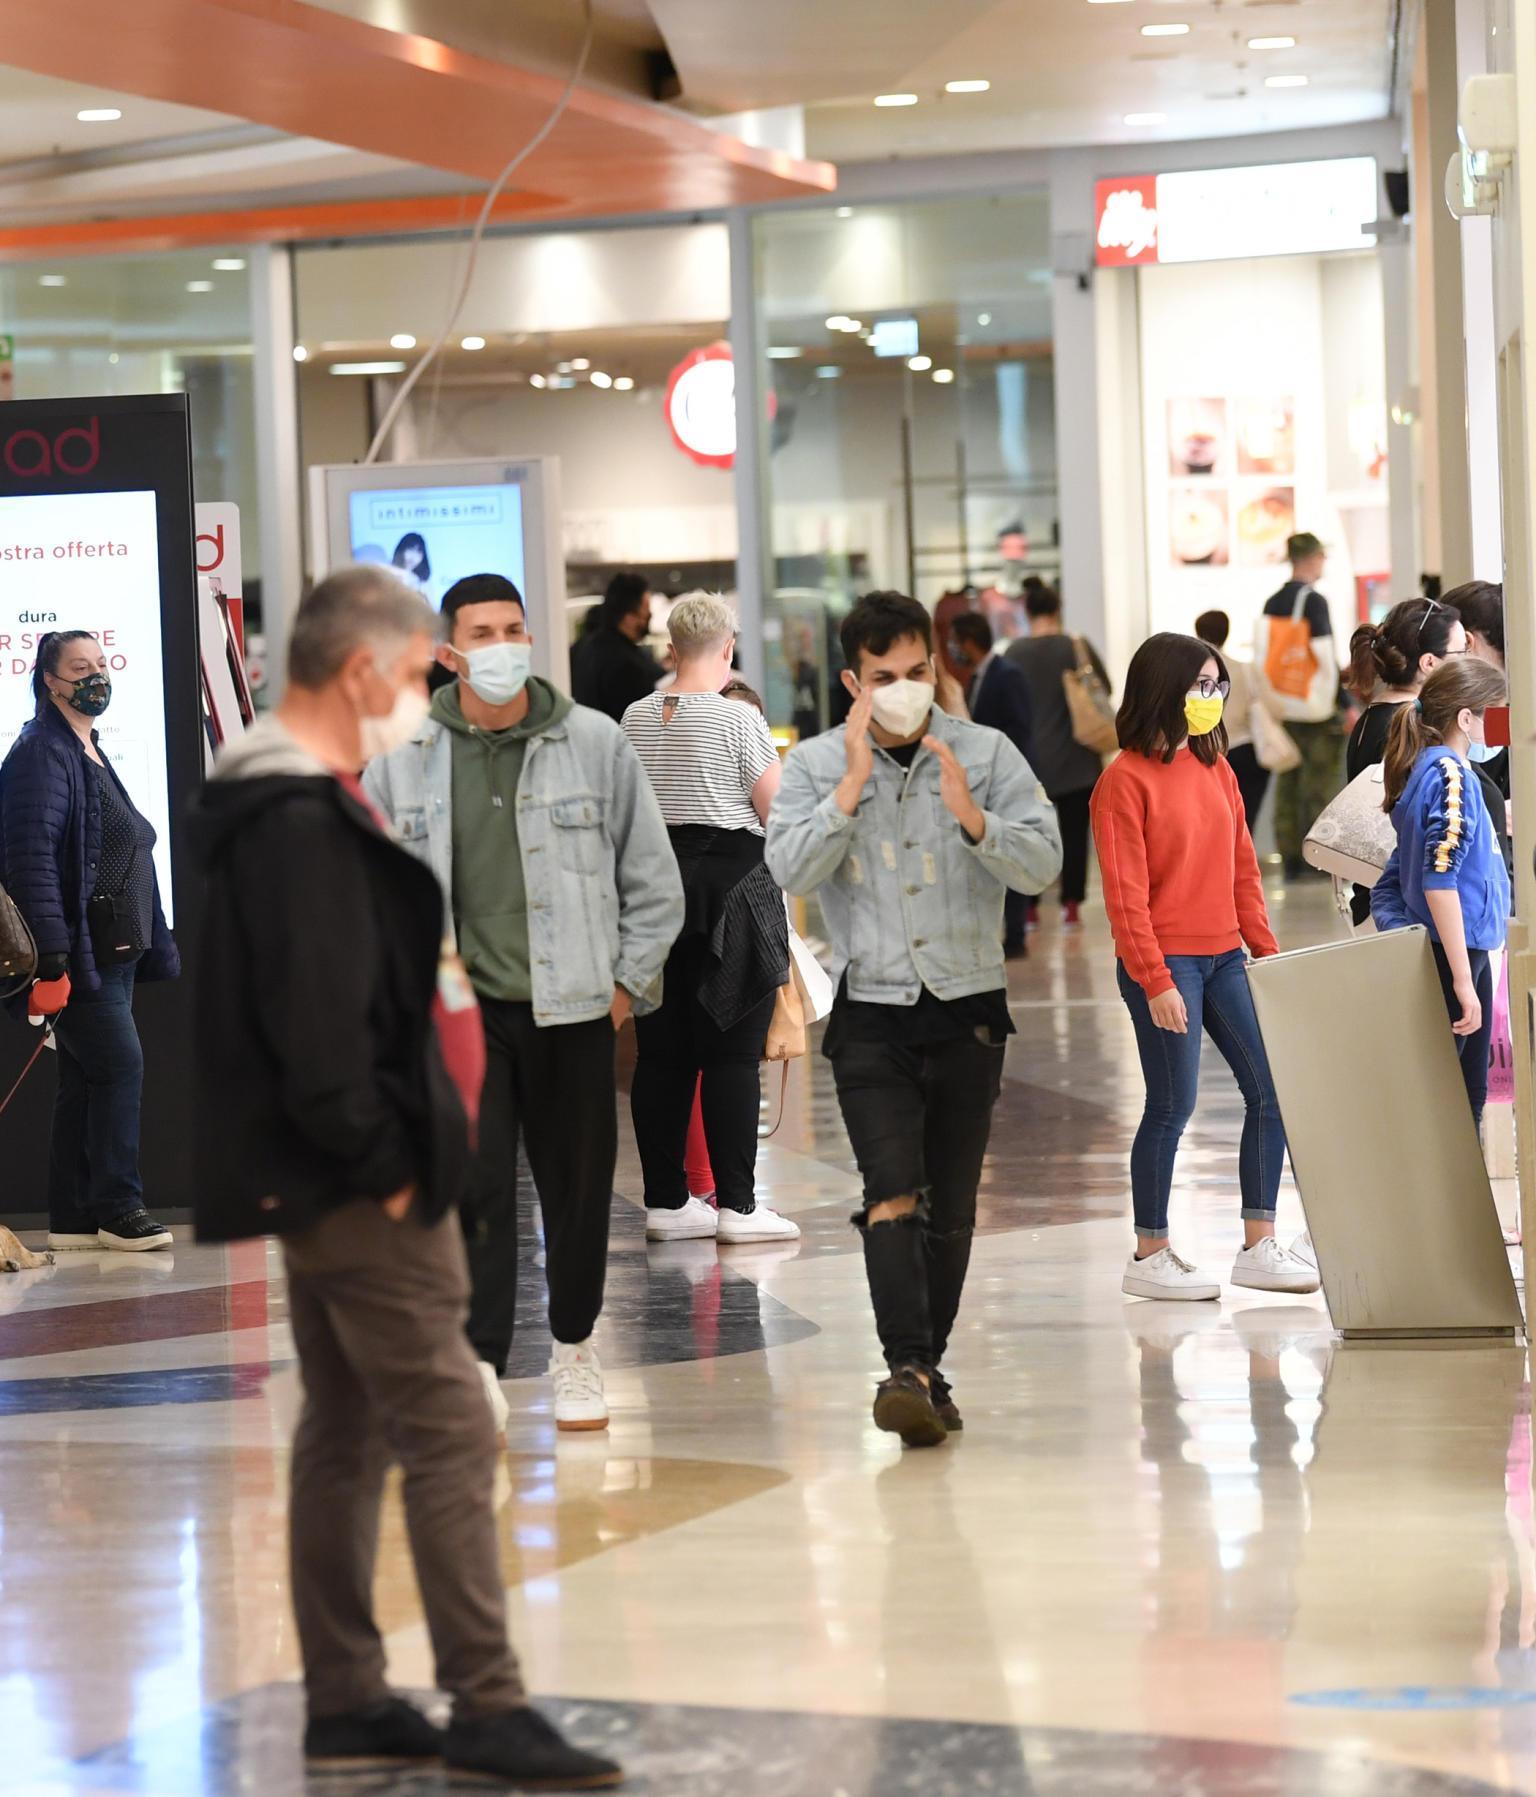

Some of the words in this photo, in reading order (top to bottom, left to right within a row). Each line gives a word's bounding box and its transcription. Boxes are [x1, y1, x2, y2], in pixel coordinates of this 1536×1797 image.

[377, 503, 495, 521] intimissimi
[52, 540, 128, 560] offerta
[18, 610, 58, 624] dura
